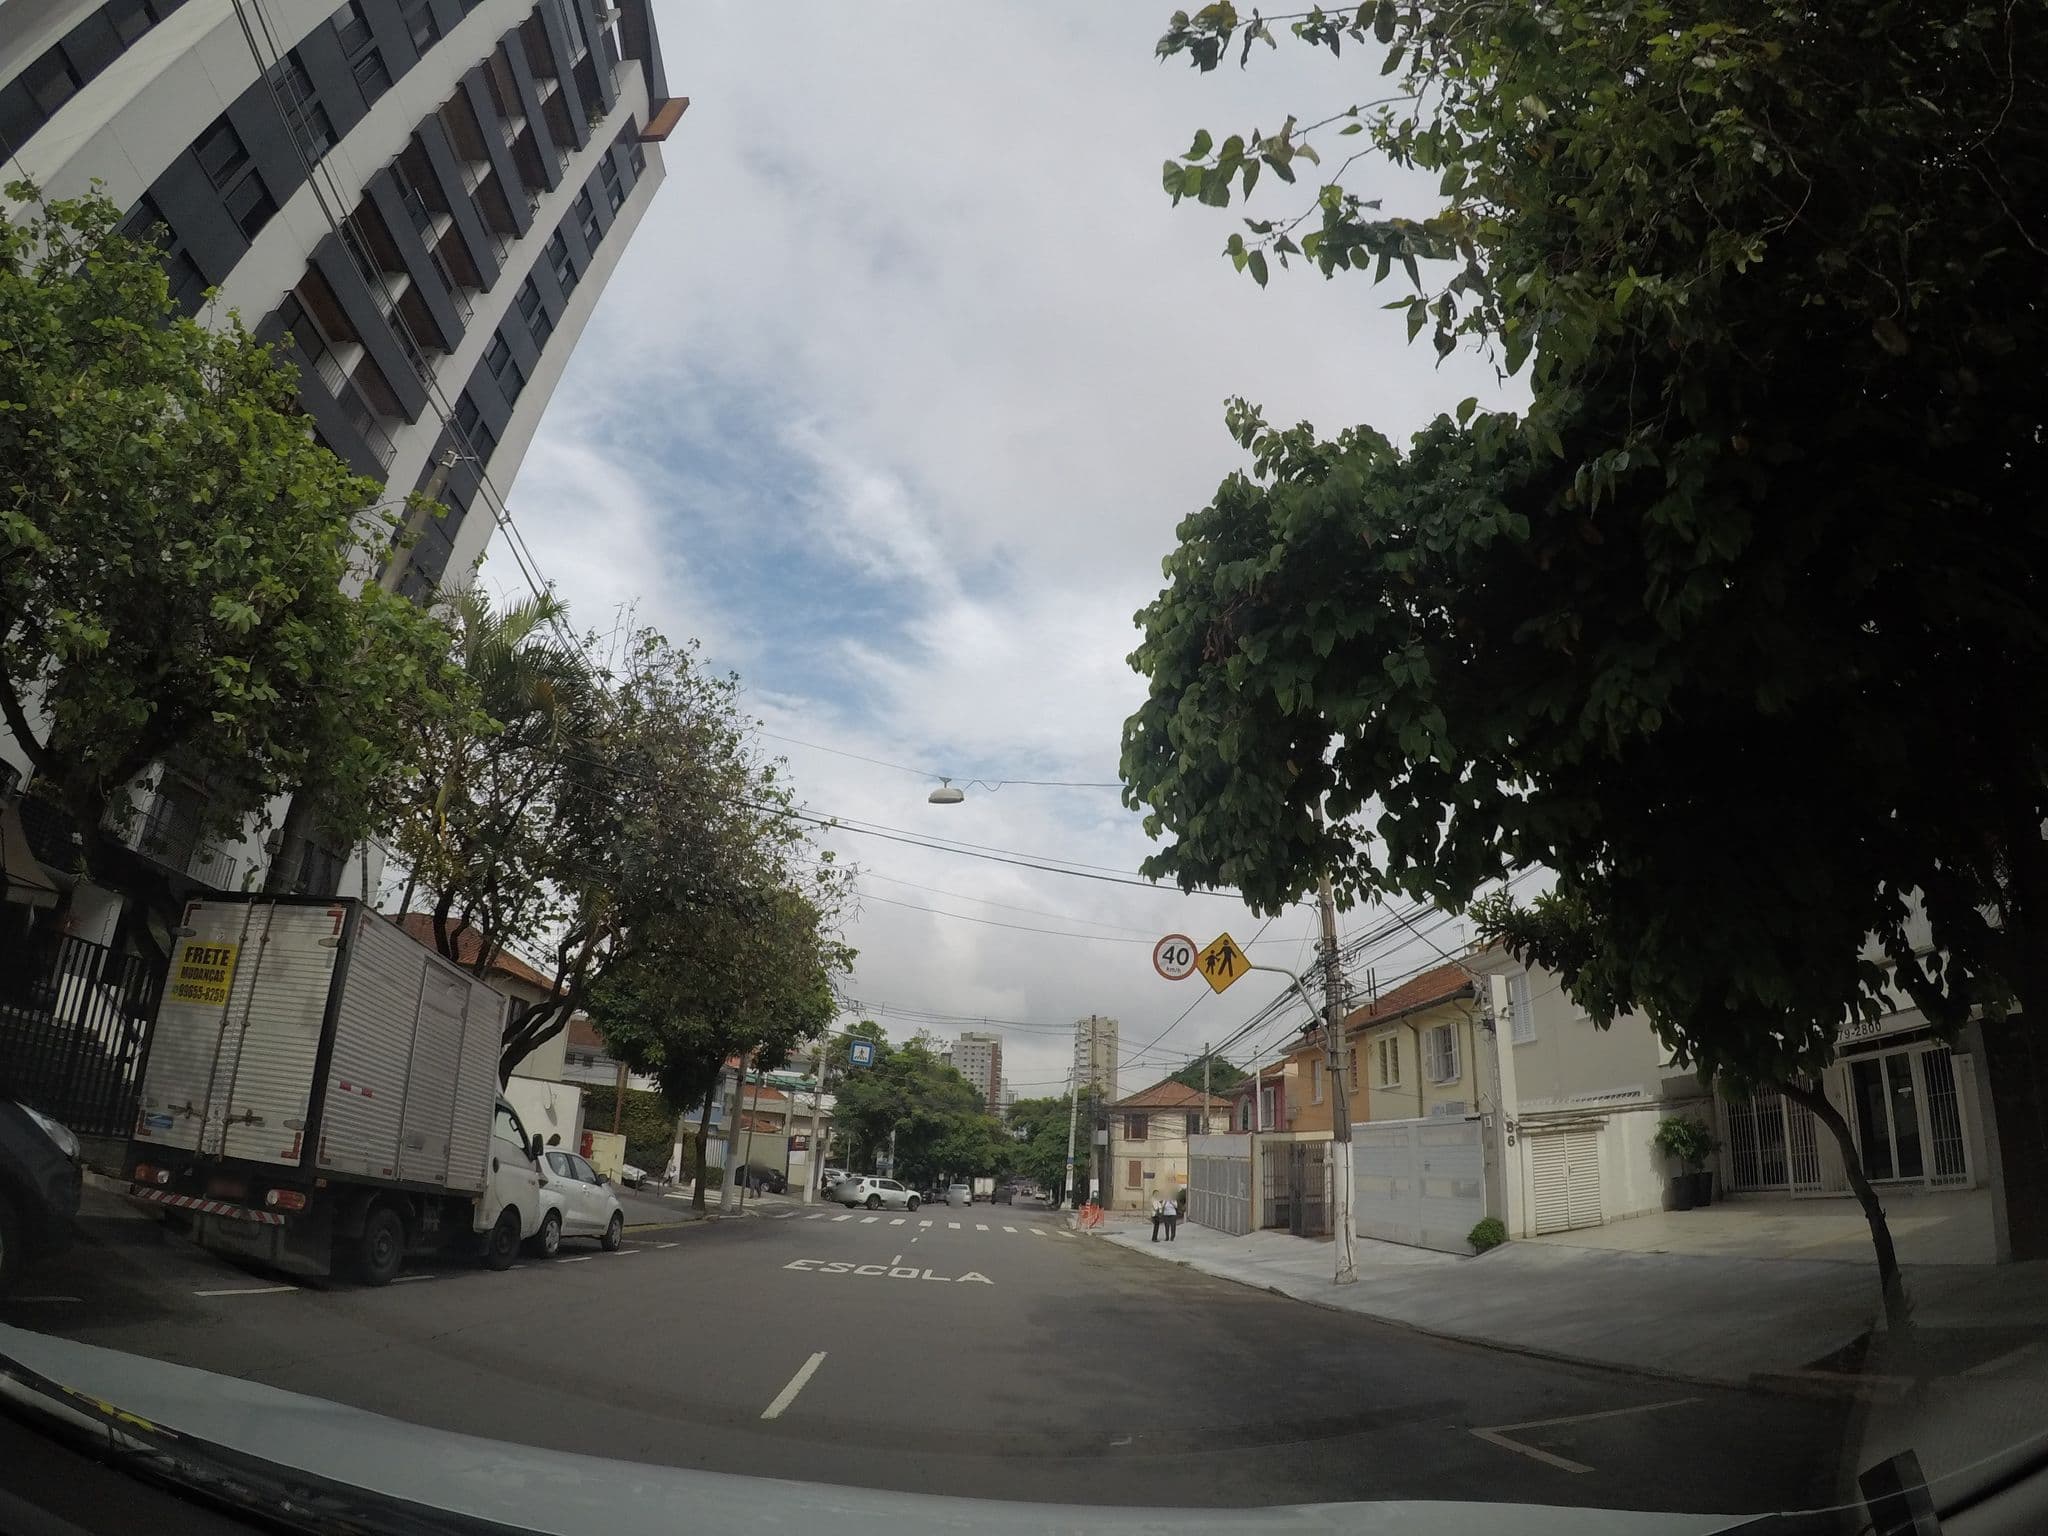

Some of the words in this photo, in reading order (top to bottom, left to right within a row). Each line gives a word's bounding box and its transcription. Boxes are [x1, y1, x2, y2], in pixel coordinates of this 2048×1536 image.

[184, 946, 231, 967] FRETE
[1162, 945, 1190, 966] 40
[782, 1258, 995, 1285] ESCOLA
